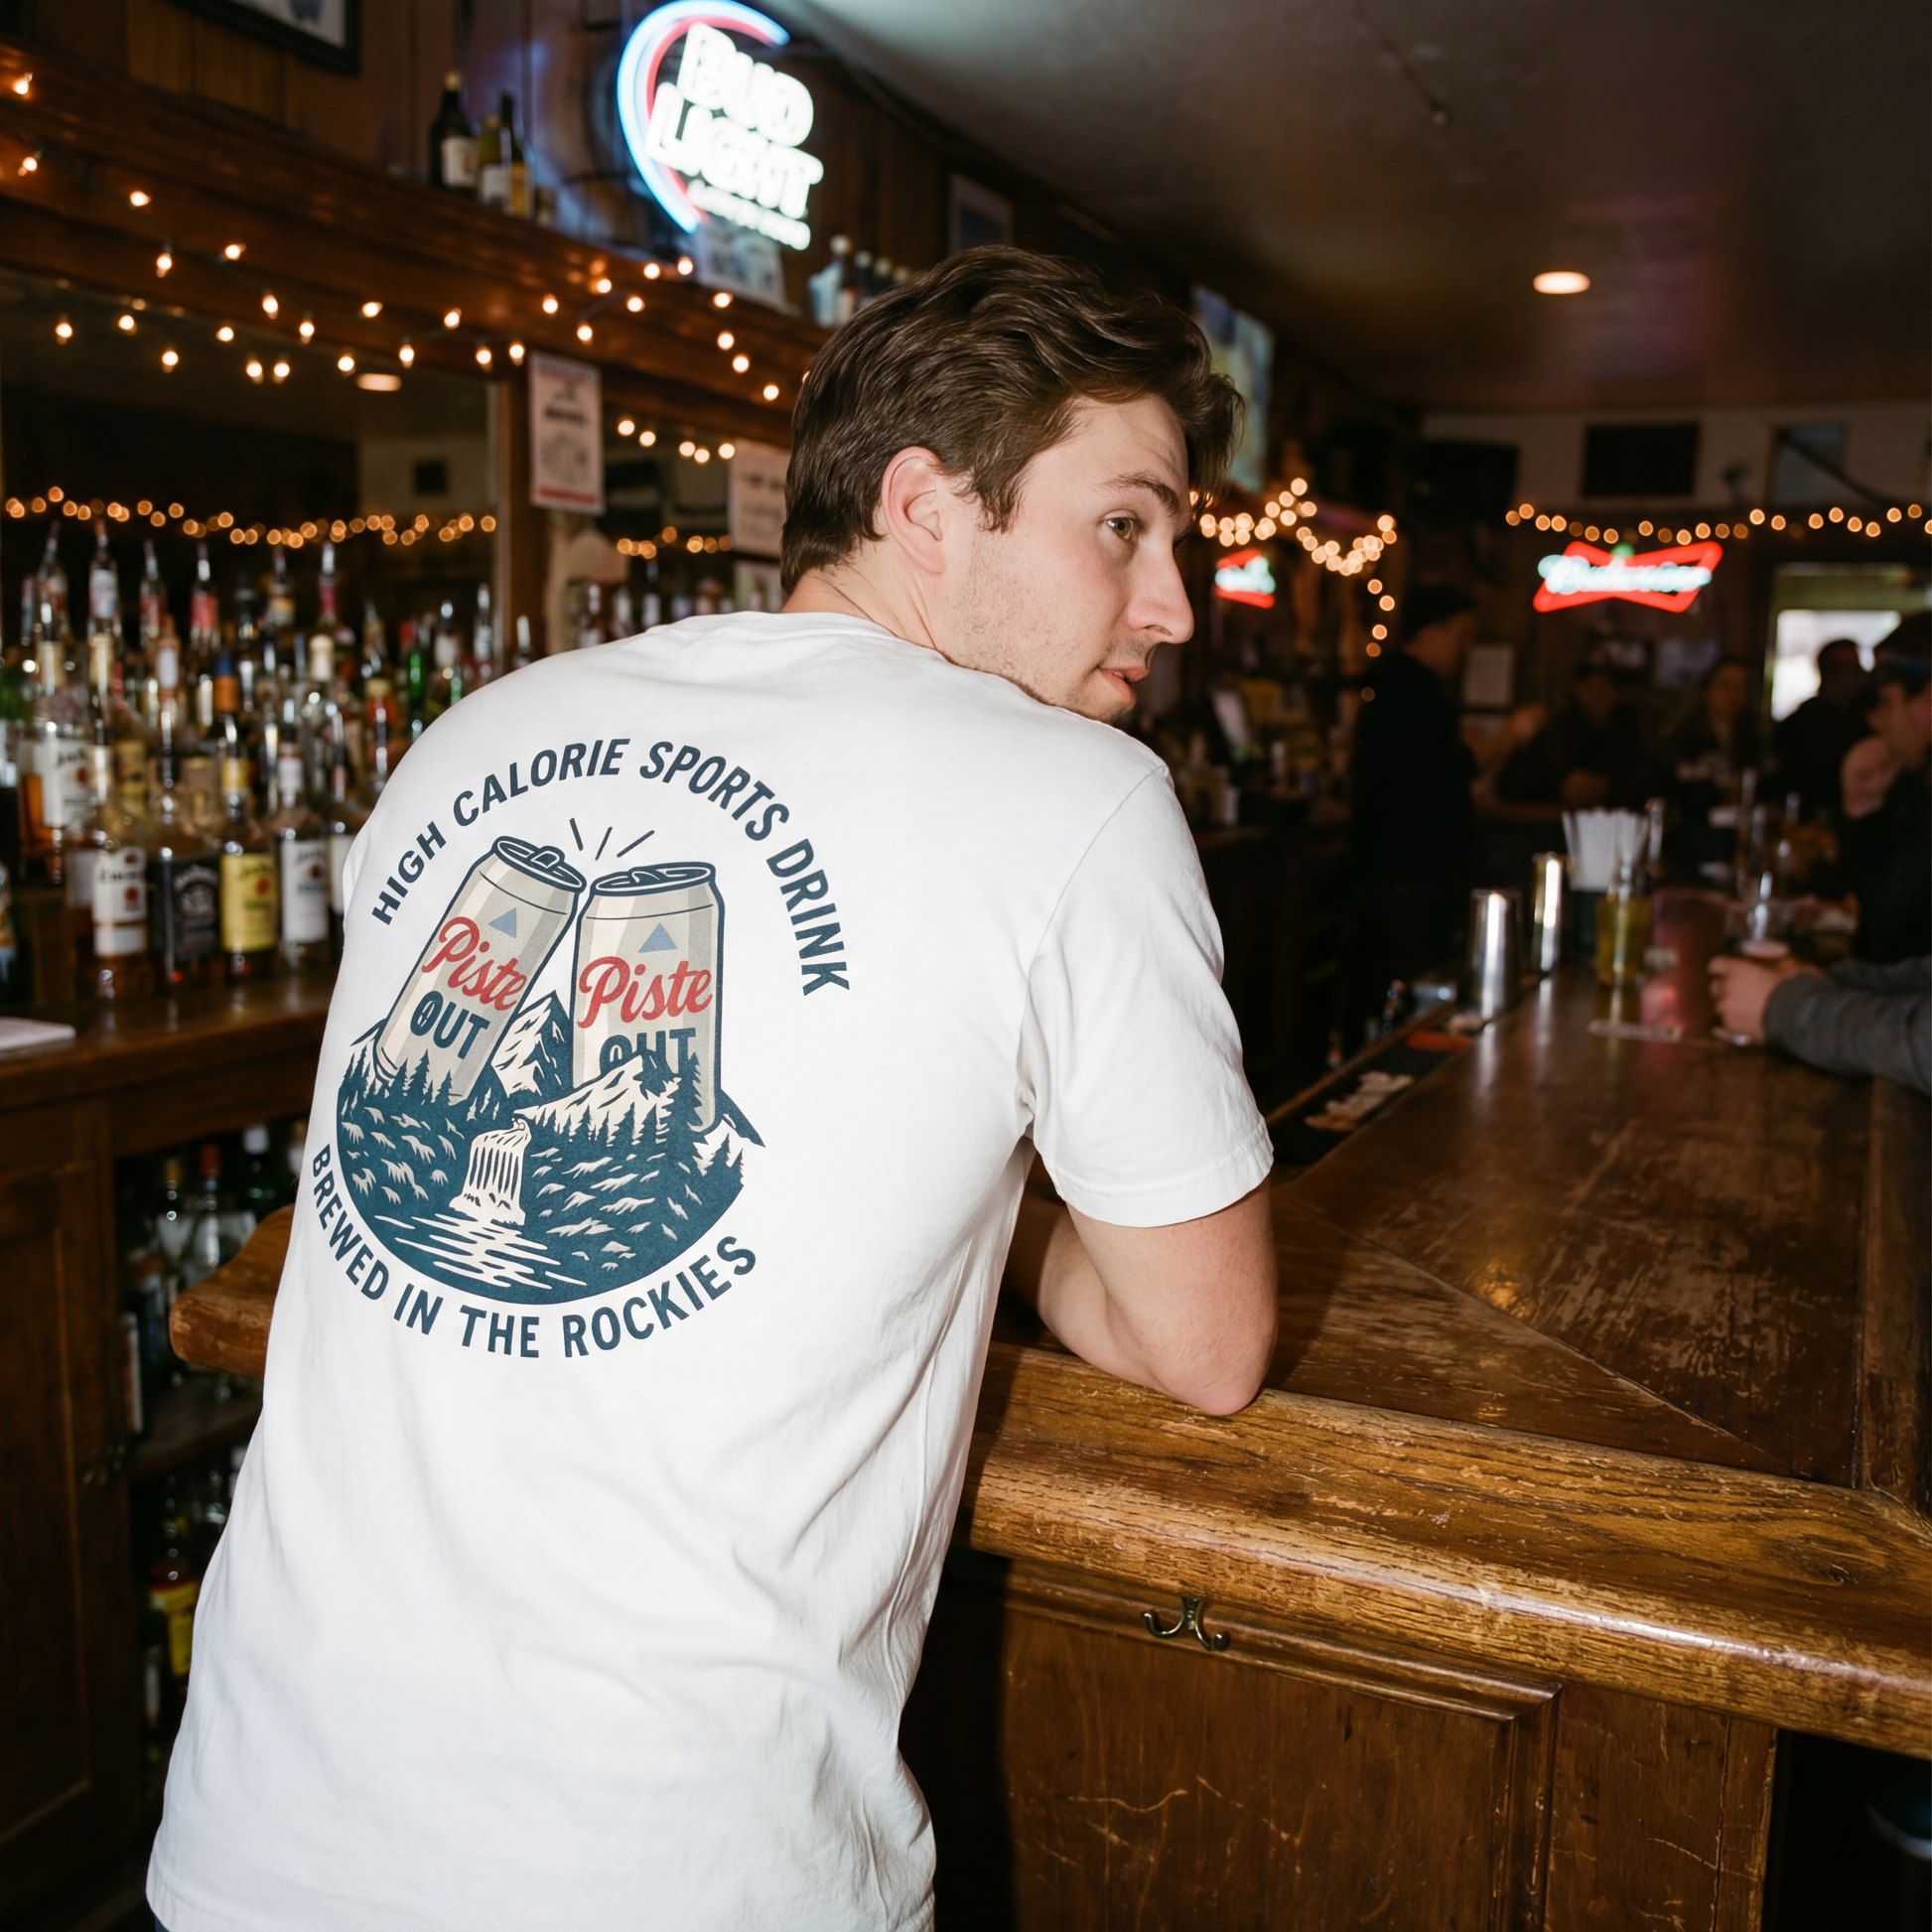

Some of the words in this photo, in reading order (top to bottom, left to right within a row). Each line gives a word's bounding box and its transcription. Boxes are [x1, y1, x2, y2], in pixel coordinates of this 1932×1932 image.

[677, 22, 814, 147] BUD
[371, 820, 447, 925] HIGH
[453, 738, 631, 827] CALORIE
[639, 741, 790, 841] SPORTS
[765, 838, 850, 997] DRINK
[421, 915, 527, 1012] Piste
[577, 955, 714, 1030] Piste
[409, 990, 491, 1060] OUT
[312, 1143, 389, 1301] BREWED
[393, 1283, 444, 1335] IN
[459, 1305, 540, 1358] THE
[562, 1236, 757, 1358] ROCKIES
